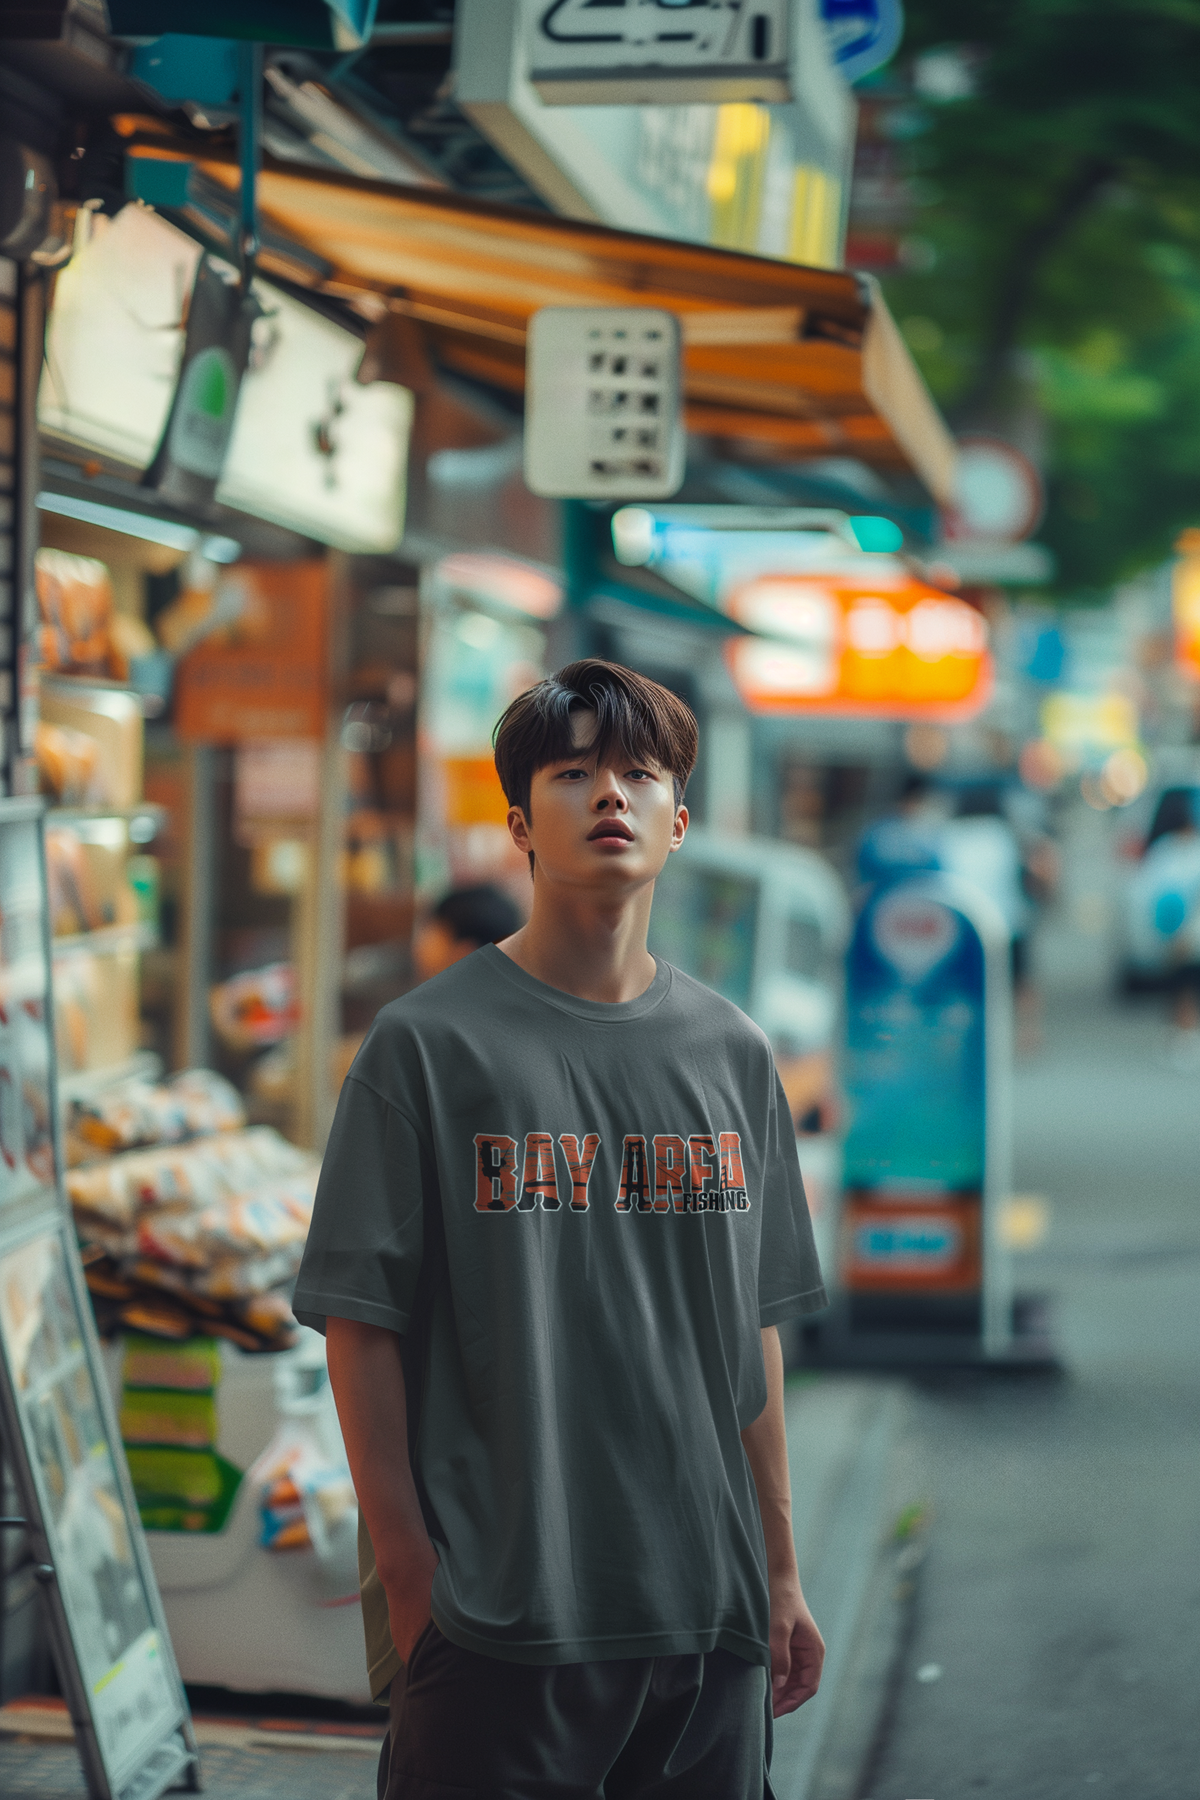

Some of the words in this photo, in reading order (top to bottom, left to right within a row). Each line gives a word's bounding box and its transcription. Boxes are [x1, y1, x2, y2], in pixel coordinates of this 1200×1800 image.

[473, 1132, 601, 1212] BAY
[614, 1131, 751, 1213] AREA
[682, 1190, 747, 1212] FISHING
